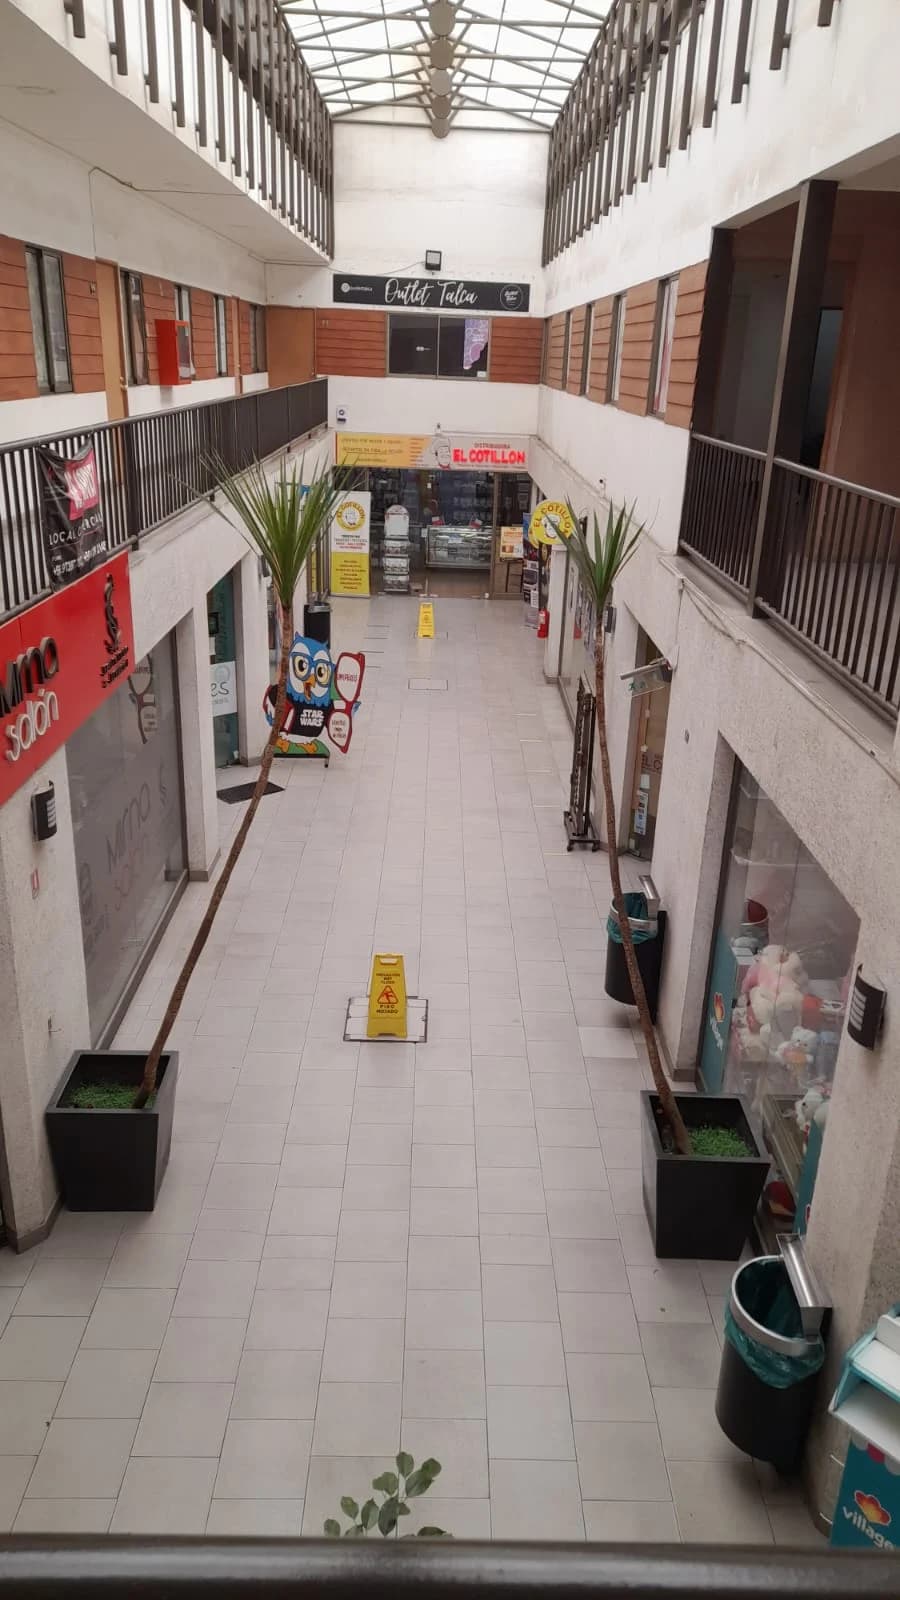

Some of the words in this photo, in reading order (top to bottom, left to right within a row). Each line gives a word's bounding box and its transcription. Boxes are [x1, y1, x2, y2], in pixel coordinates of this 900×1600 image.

[384, 278, 434, 305] Outlet
[437, 281, 478, 306] Talca
[453, 448, 467, 462] EL
[469, 449, 526, 464] COTILLON
[49, 528, 77, 546] LOCAL
[300, 717, 325, 727] WARS
[301, 708, 324, 719] STAR
[5, 688, 60, 761] salón
